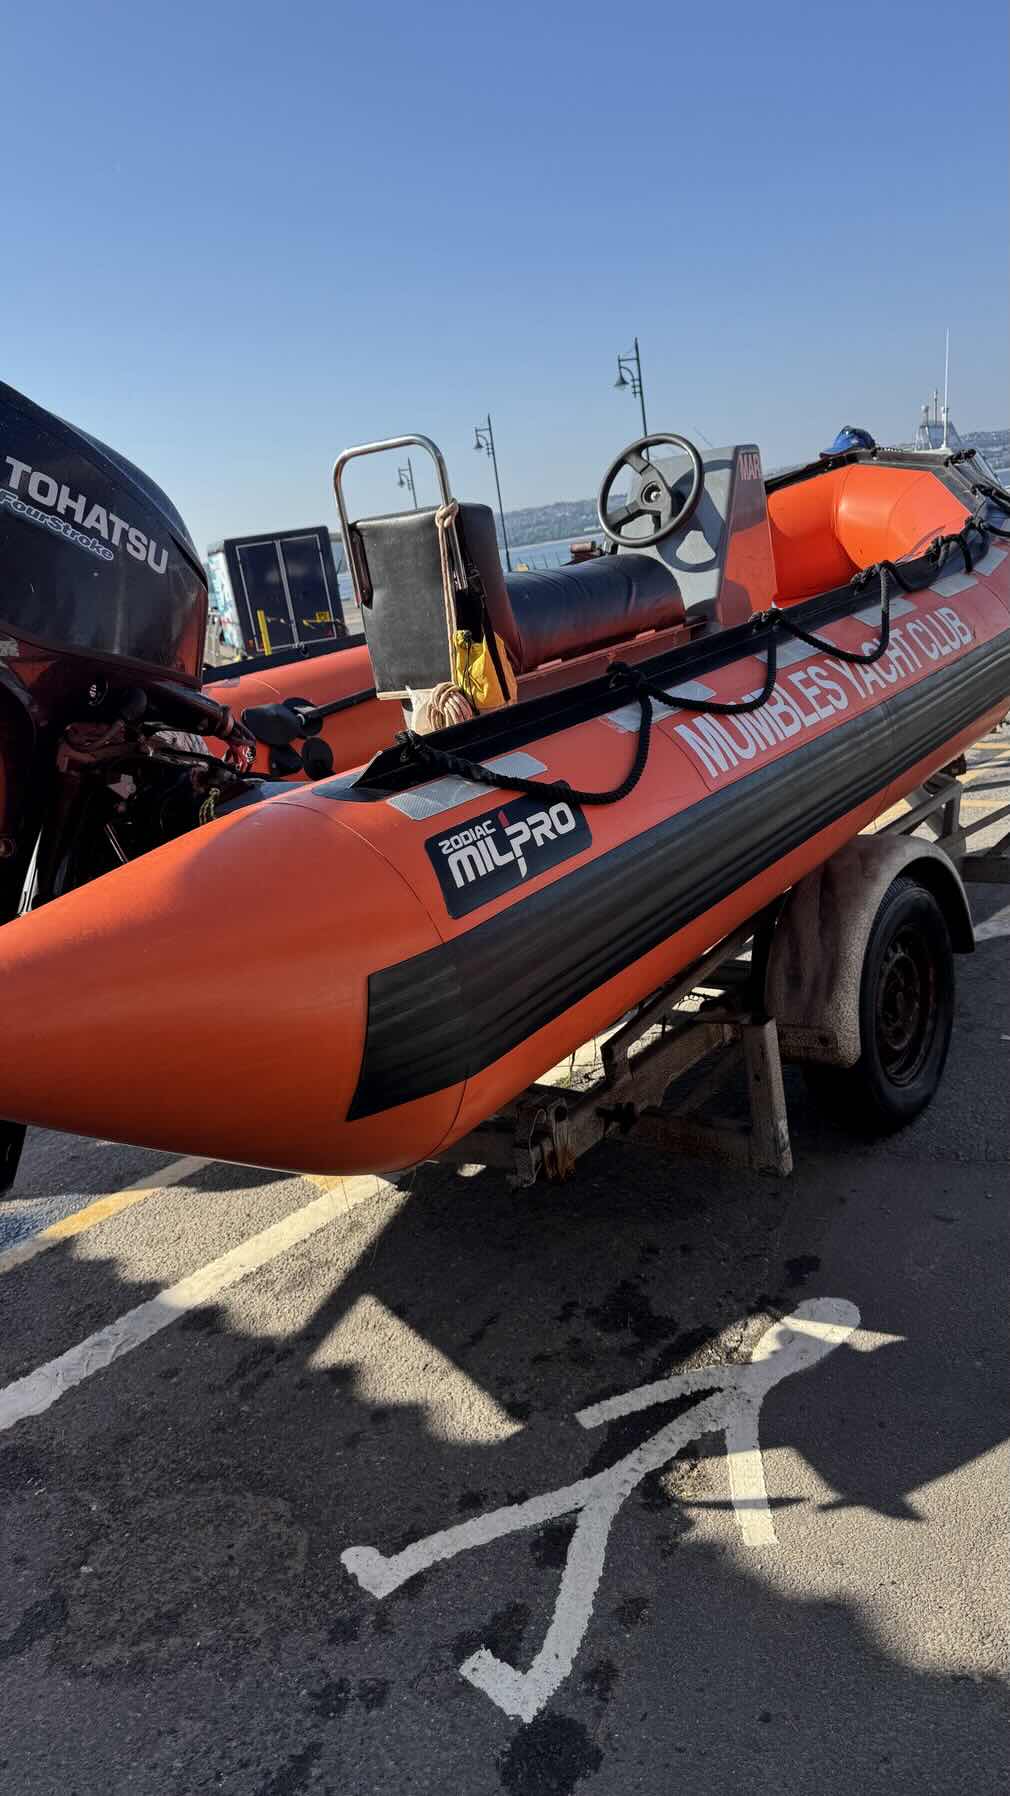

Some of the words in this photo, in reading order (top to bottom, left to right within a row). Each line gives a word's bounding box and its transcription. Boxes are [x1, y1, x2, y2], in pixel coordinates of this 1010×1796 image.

[5, 455, 169, 574] TOHATSU
[672, 665, 849, 778] MUMBLES
[905, 607, 973, 661] CLUB
[438, 819, 497, 855] ZODIAC
